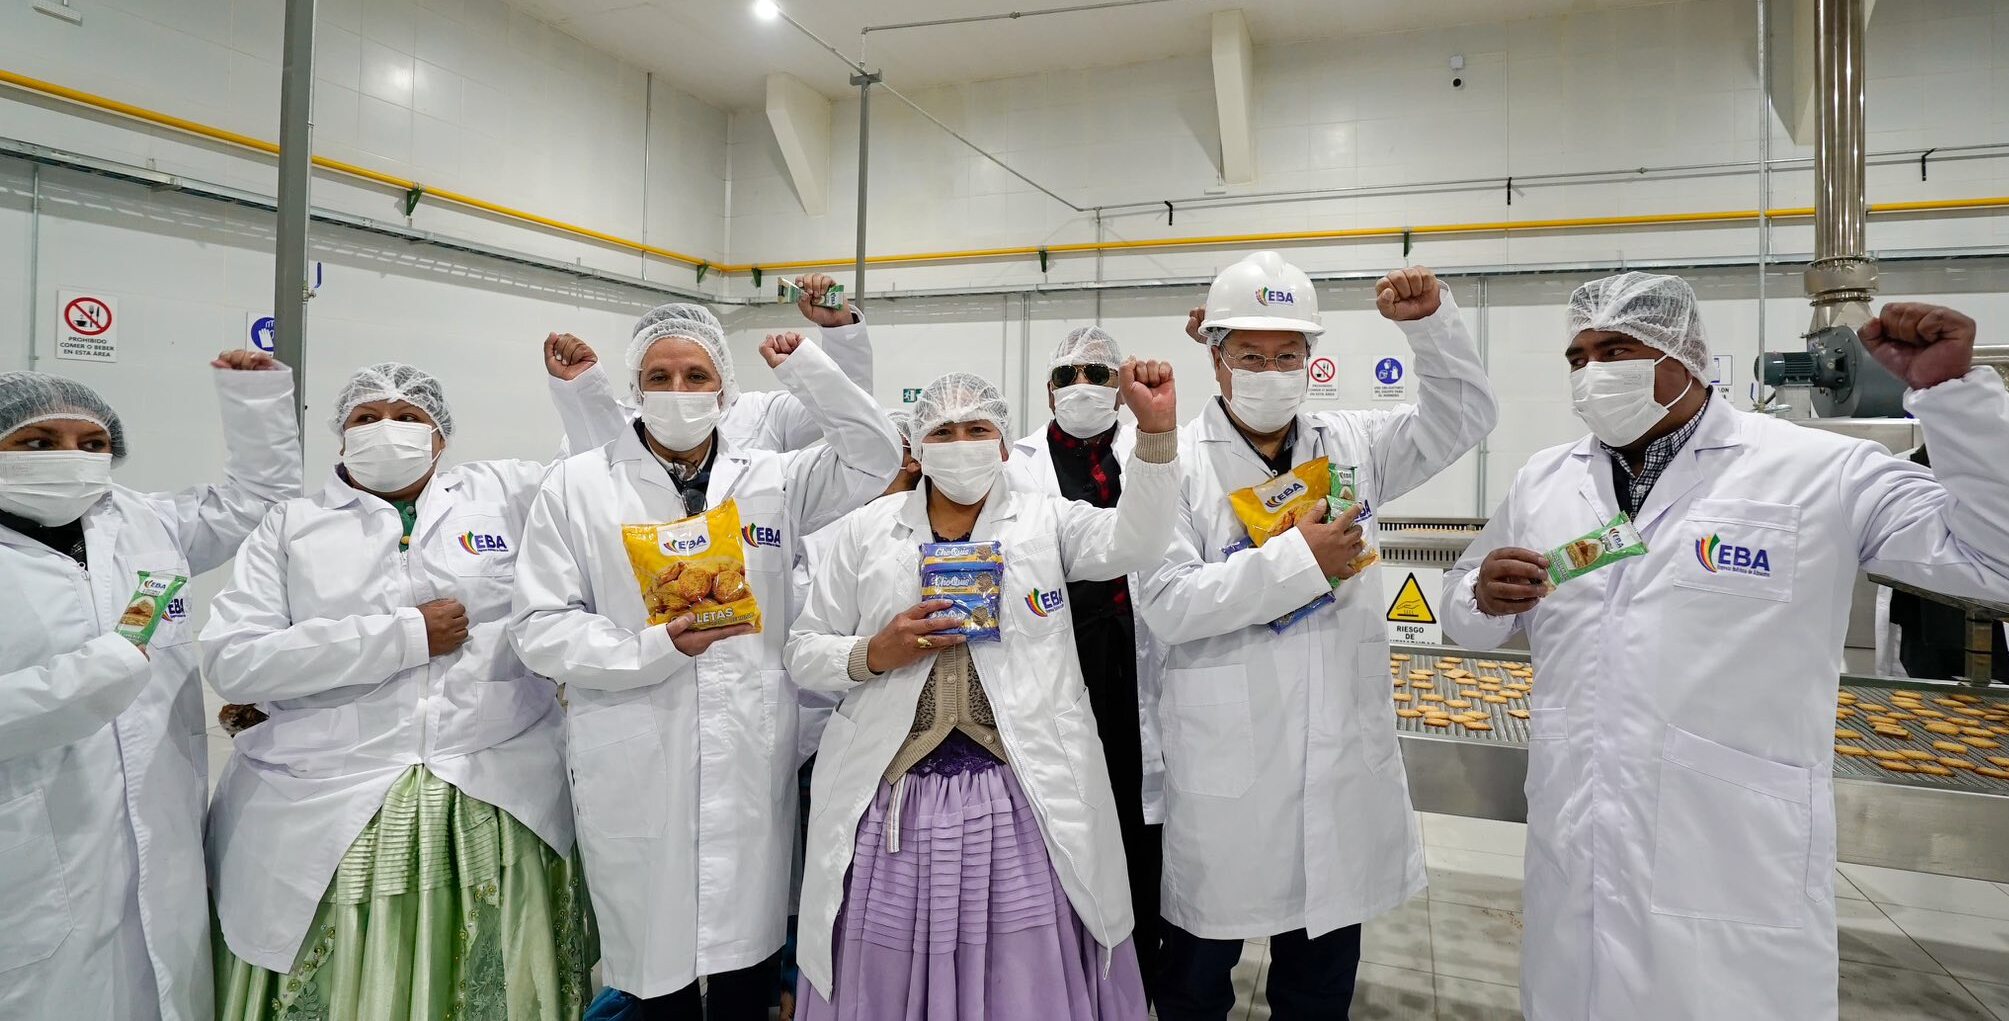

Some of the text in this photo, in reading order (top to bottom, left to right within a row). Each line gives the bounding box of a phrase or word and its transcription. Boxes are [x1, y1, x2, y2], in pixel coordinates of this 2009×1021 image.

[1268, 290, 1294, 303] EBA
[68, 336, 107, 344] PROHIBIDO
[1277, 482, 1304, 501] EBA
[474, 534, 507, 549] EBA
[678, 535, 706, 549] EBA
[756, 527, 781, 544] EBA
[1718, 544, 1770, 572] EBA
[1396, 625, 1424, 633] RIESGO
